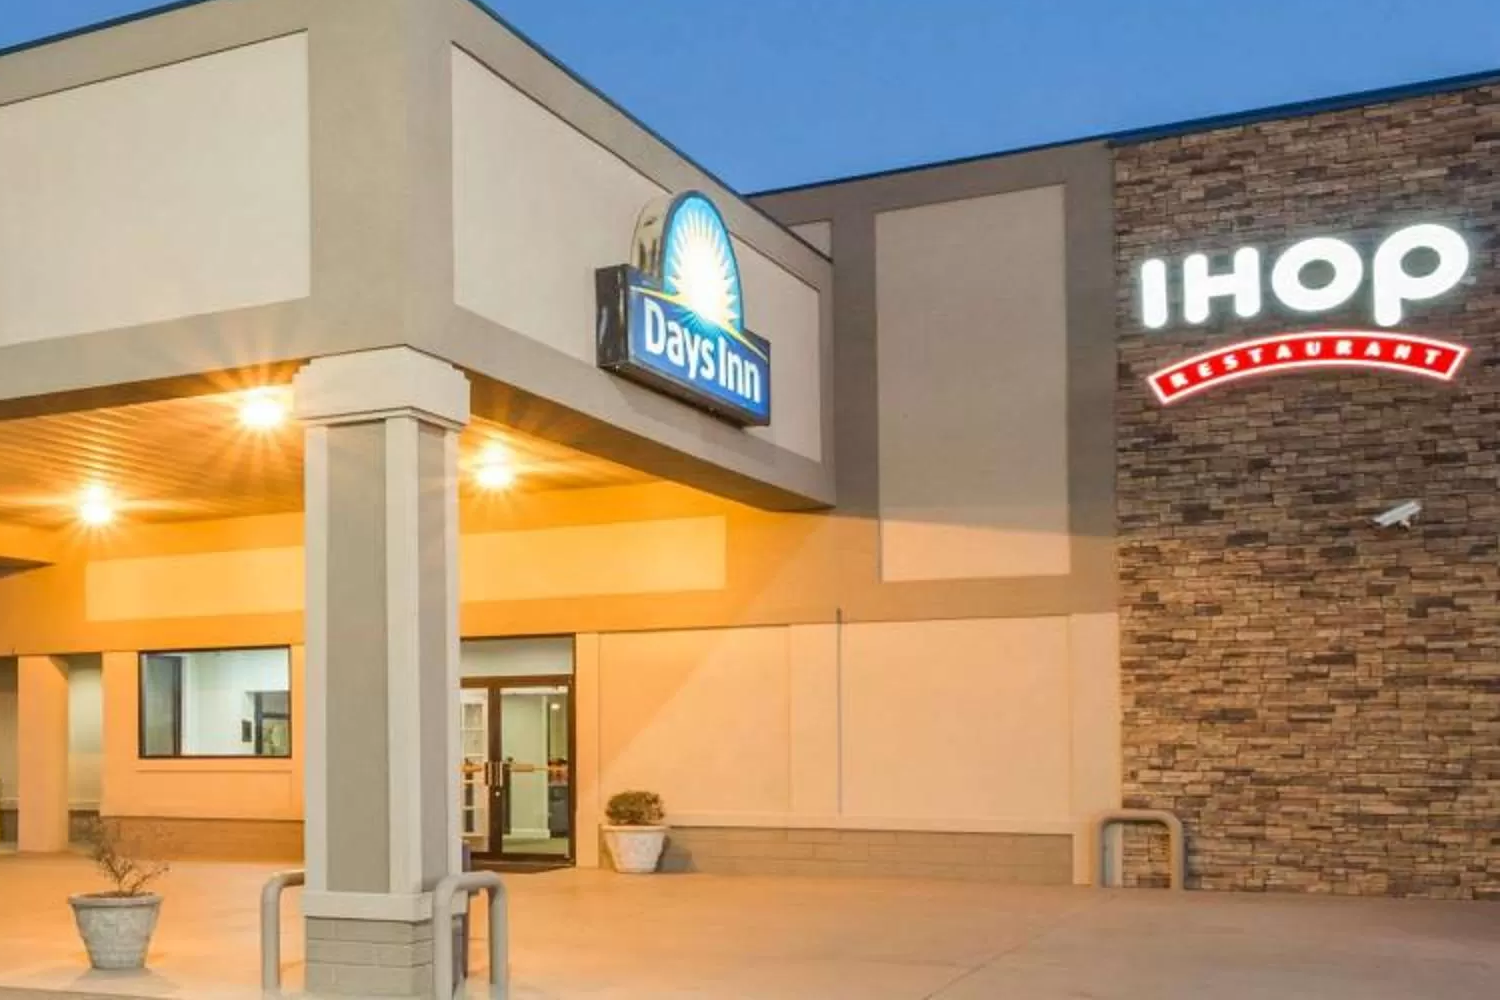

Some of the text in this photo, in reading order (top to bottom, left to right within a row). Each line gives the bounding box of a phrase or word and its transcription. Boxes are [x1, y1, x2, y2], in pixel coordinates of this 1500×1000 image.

[1141, 223, 1469, 329] IHOP
[644, 297, 761, 404] Days Inn
[1168, 339, 1442, 389] RESTAURANT
